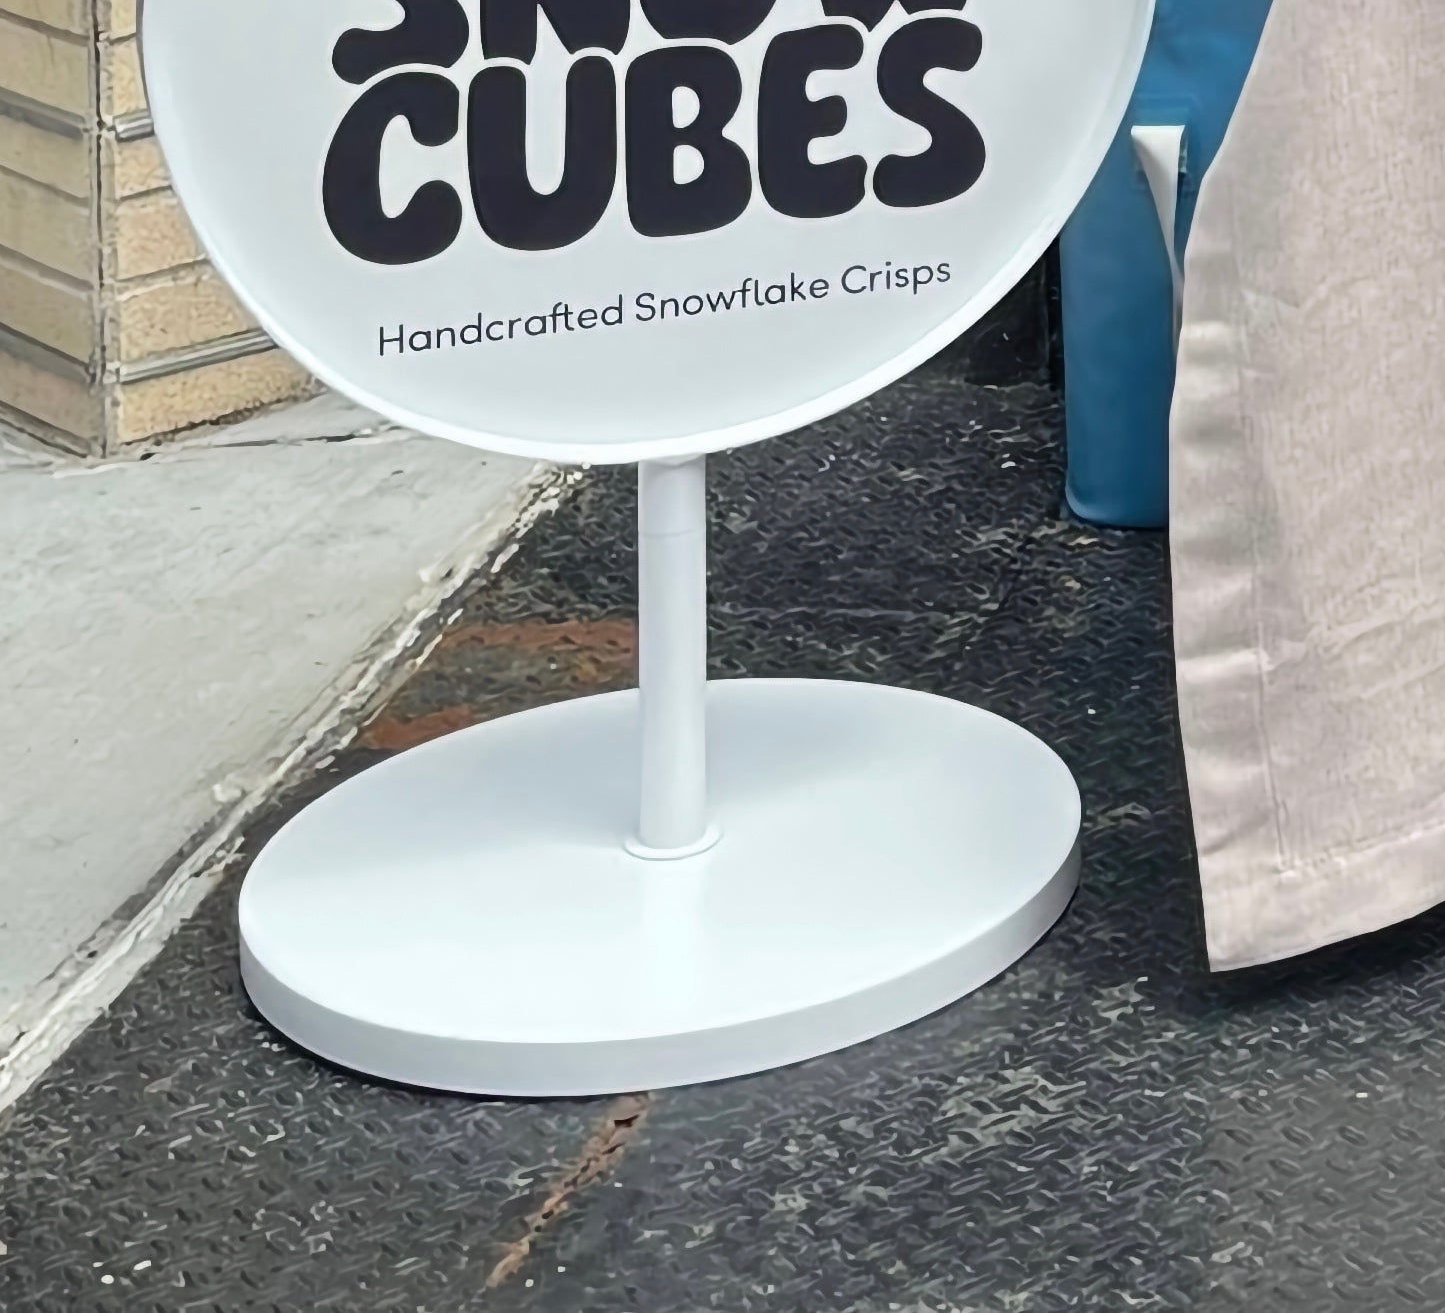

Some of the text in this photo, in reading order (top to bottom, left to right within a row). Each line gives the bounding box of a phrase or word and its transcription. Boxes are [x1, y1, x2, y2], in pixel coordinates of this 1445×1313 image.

[323, 17, 987, 266] CUBES
[377, 259, 952, 357] Handcrafted Snowflake Crisps
